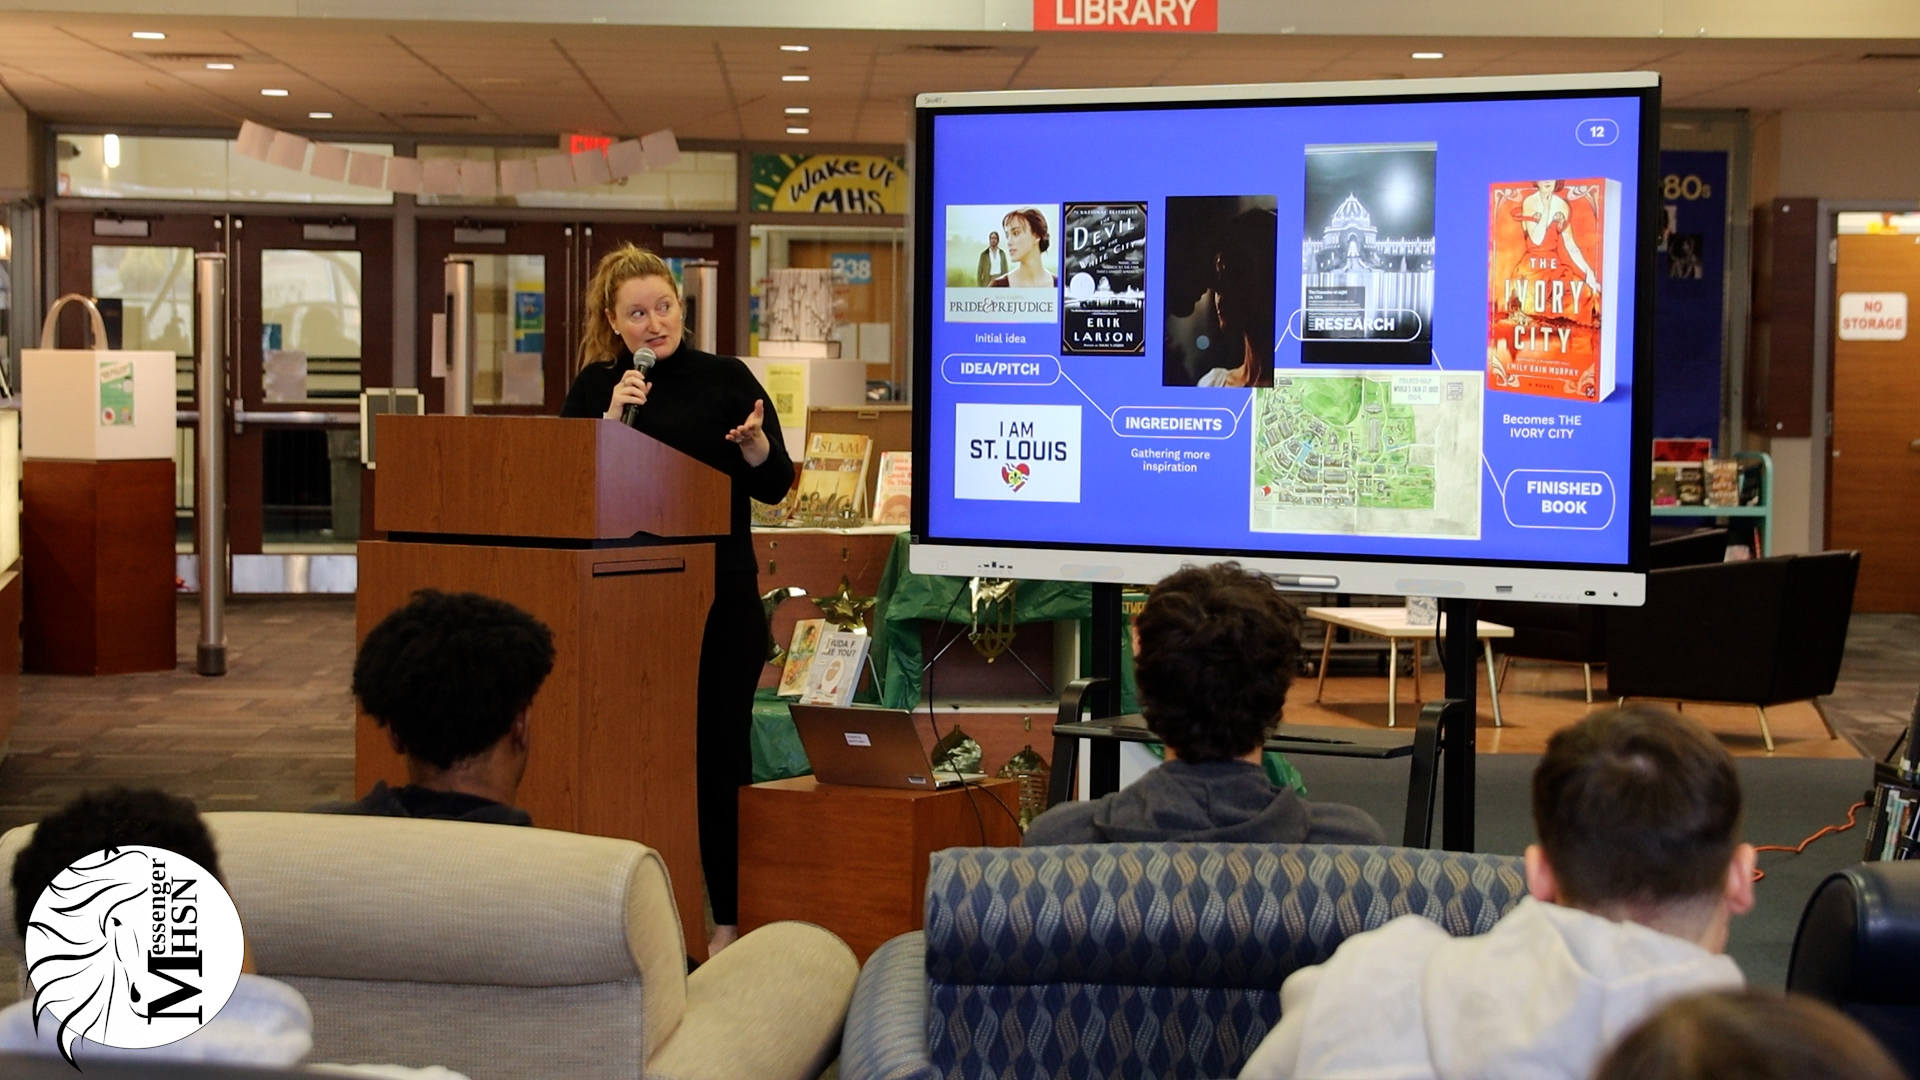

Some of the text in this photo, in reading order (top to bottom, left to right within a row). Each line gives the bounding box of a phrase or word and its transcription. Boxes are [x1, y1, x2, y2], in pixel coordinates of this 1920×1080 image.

[1056, 0, 1198, 25] LIBRARY
[1590, 126, 1605, 138] 12
[814, 188, 884, 213] MHS
[1073, 217, 1134, 251] DEVIL
[1079, 242, 1135, 269] WHITE CITY
[832, 258, 870, 280] 238
[1530, 258, 1557, 269] THE
[1504, 279, 1584, 315] IVORY
[1864, 301, 1883, 313] NO
[1087, 317, 1120, 328] ERIK
[1314, 317, 1395, 331] RESEARCH
[1843, 317, 1903, 330] STORAGE
[975, 333, 1026, 344] Initial idea
[1074, 332, 1133, 342] LARSON
[1514, 325, 1571, 354] CITY
[960, 362, 1040, 376] IDEA/PITCH
[1507, 362, 1528, 372] EMILY
[1549, 367, 1579, 377] MURPHY
[1125, 416, 1223, 431] INGREDIENTS
[1503, 414, 1582, 426] Becomes THE
[1000, 421, 1034, 438] I AM
[1510, 428, 1574, 439] IVORY CITY
[819, 440, 860, 454] SLAM
[970, 439, 1067, 461] ST. LOUIS
[1131, 447, 1211, 460] Gathering more
[1143, 460, 1198, 473] inspiration
[1527, 480, 1603, 496] FINISHED
[1542, 500, 1588, 514] BOOK
